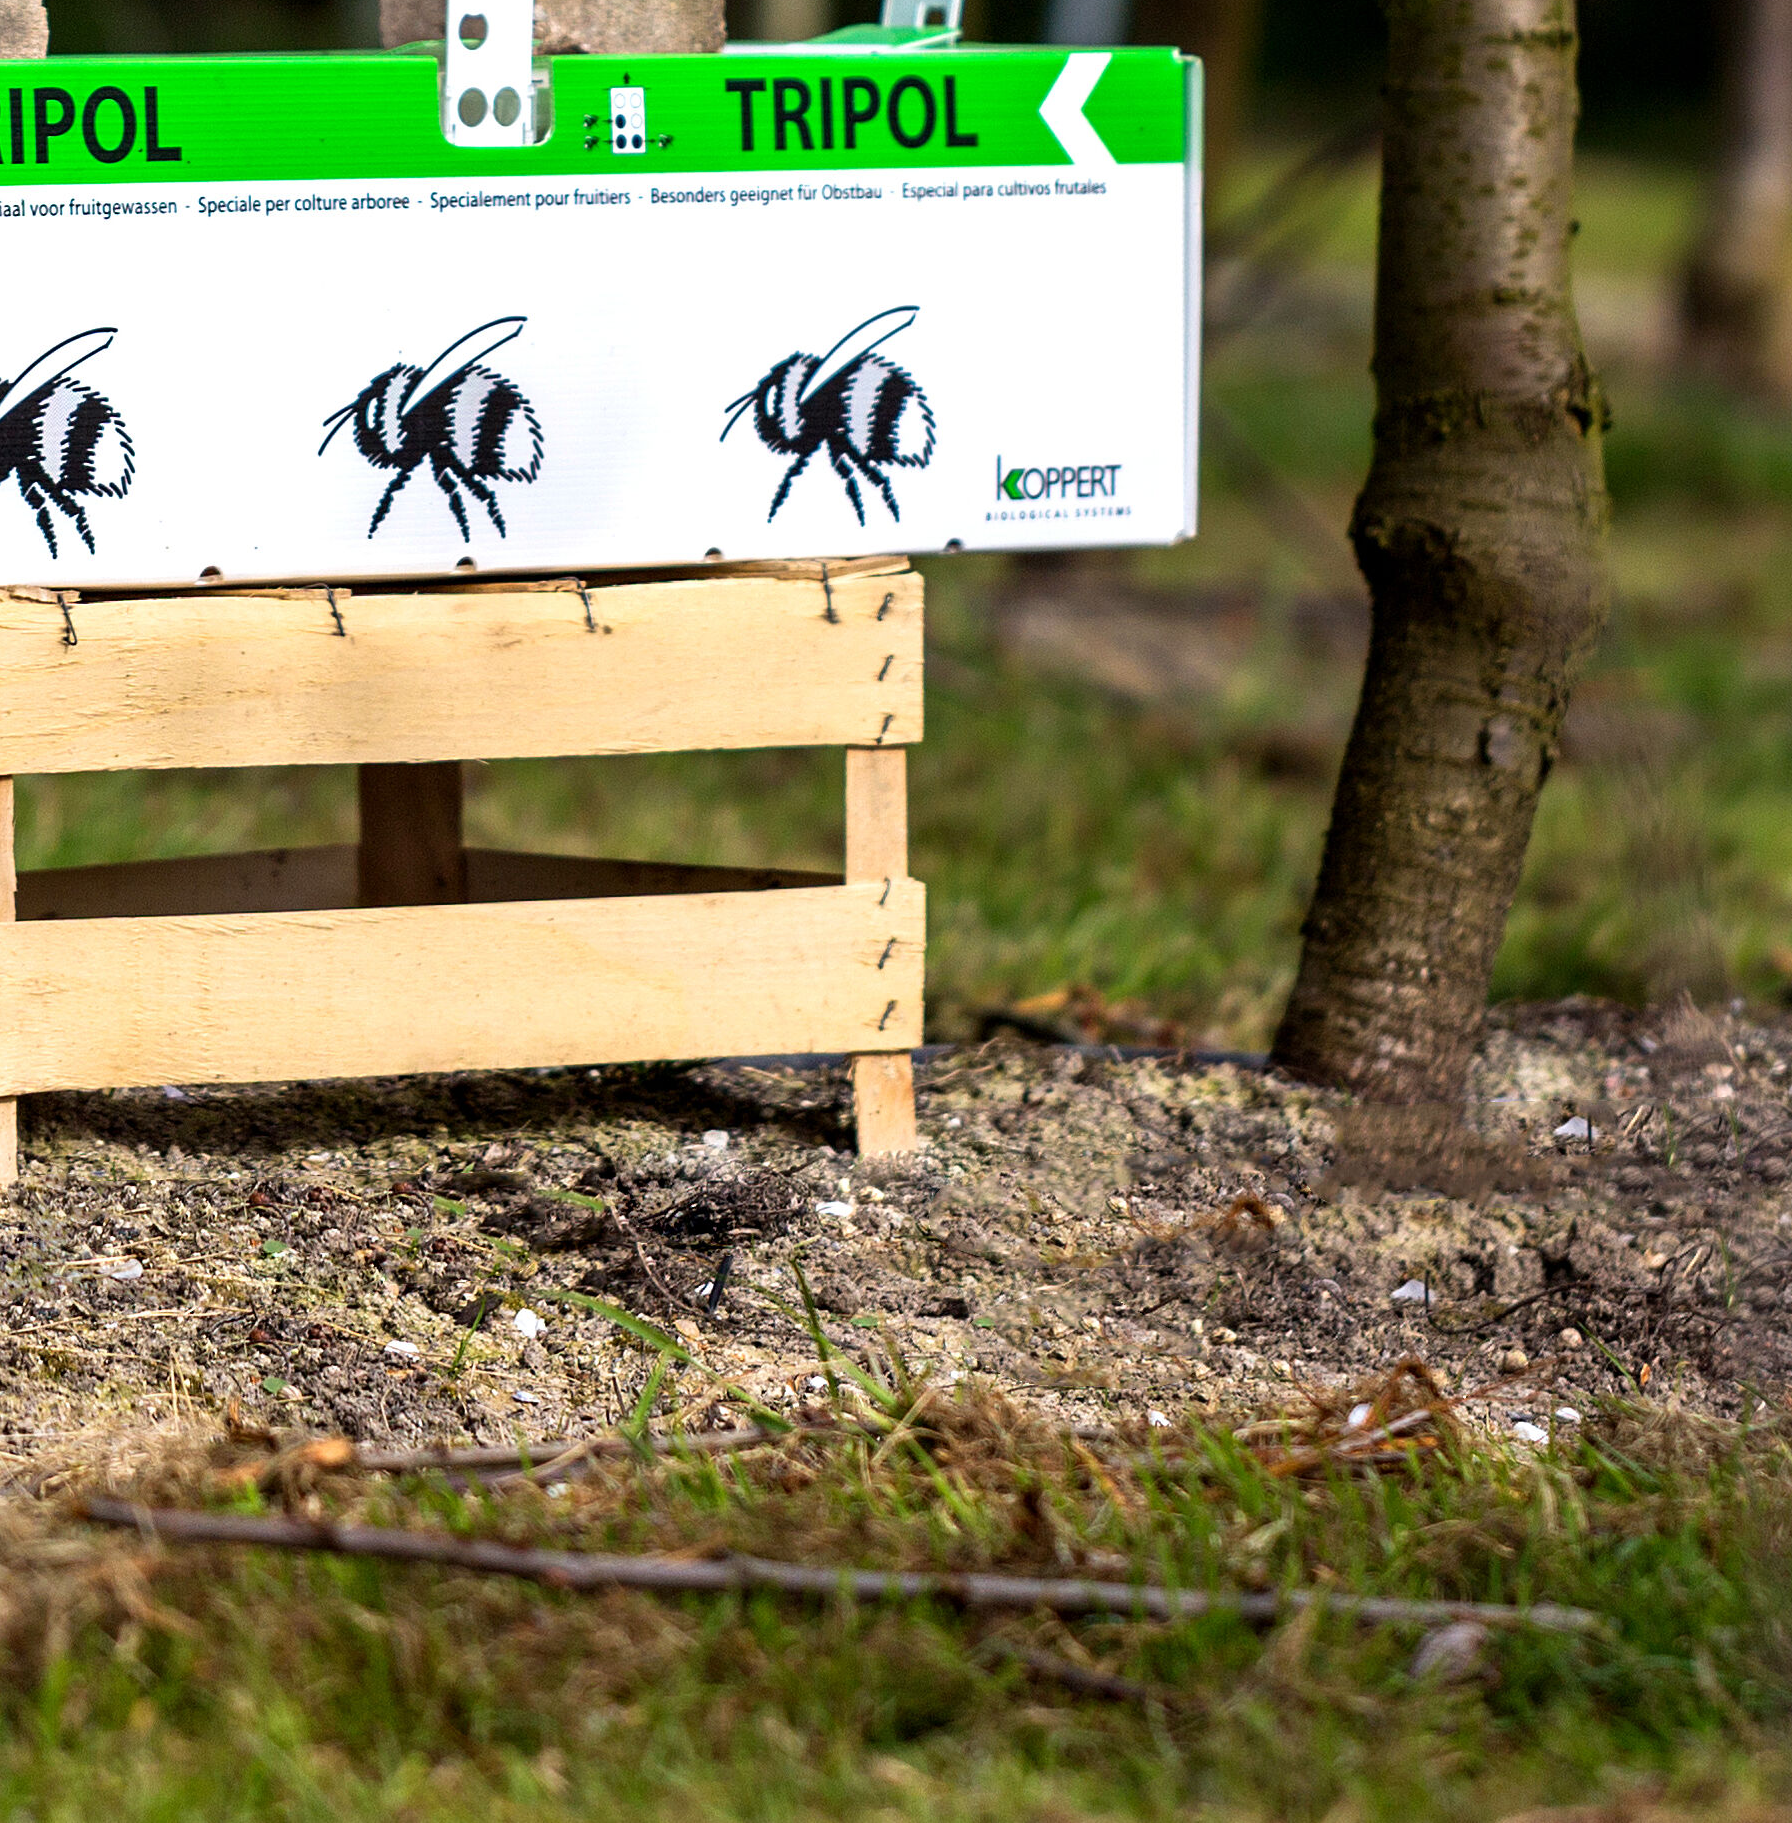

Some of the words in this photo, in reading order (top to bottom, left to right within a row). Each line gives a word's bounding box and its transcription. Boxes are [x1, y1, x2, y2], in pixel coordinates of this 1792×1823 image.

[725, 75, 978, 151] TRIPOL
[29, 203, 64, 218] voor
[68, 198, 178, 220] fruitgewassen
[198, 195, 261, 217] Speciale
[265, 199, 291, 216] per
[294, 193, 348, 212] colture
[351, 193, 410, 211] arboree
[430, 190, 531, 212] Specialement
[535, 193, 570, 210] pour
[573, 188, 631, 206] fruitiers
[650, 187, 726, 204] Besonders
[729, 187, 794, 207] geeignet
[797, 184, 818, 201] für
[821, 183, 882, 201] Obstbau
[902, 182, 958, 201] Especial
[962, 184, 994, 201] para
[997, 181, 1051, 197] cultivos
[1054, 179, 1107, 195] frutales
[985, 509, 1068, 522] BIOLOGICAL
[1076, 506, 1132, 518] SYSTEMS
